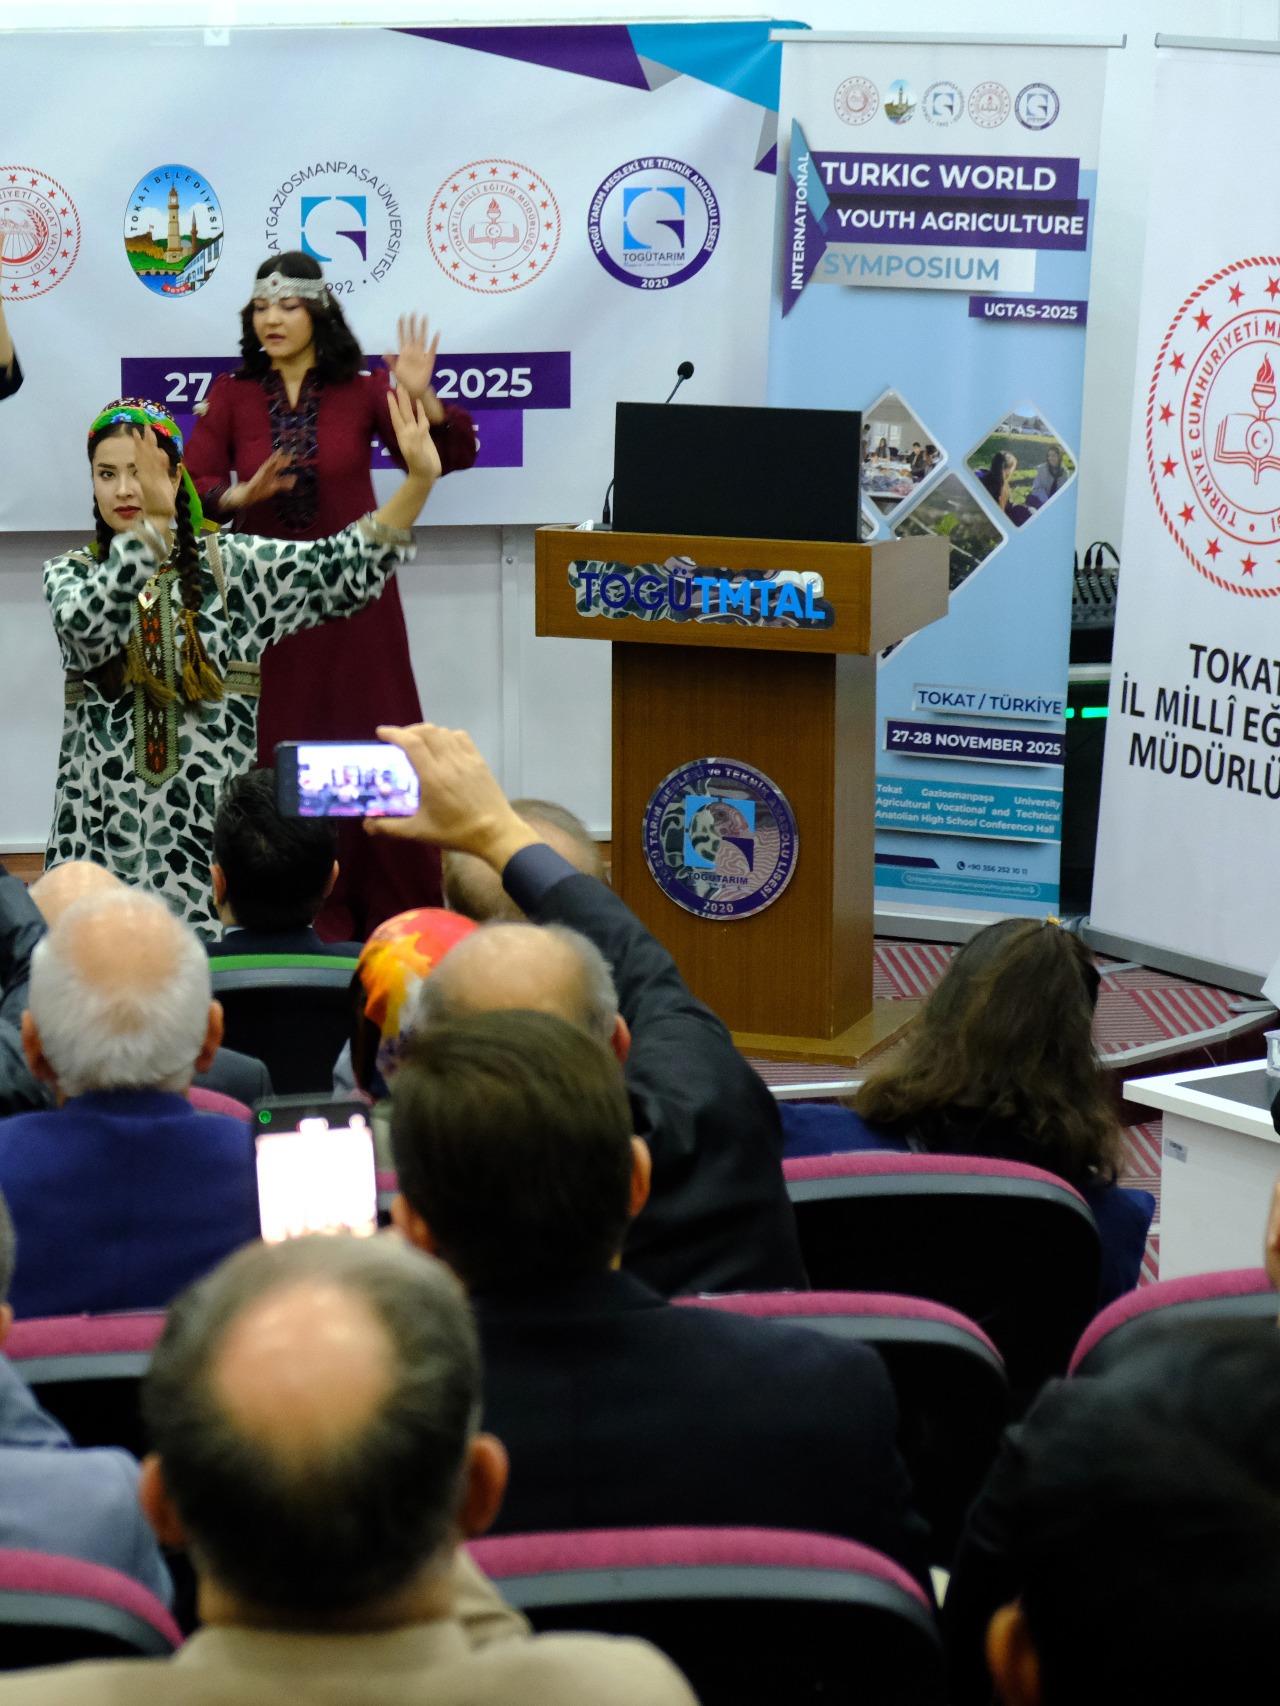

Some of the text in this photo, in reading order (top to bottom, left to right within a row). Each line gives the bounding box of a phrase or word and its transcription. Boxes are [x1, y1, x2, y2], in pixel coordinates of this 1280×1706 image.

[641, 159, 655, 168] VE
[690, 175, 718, 217] ANADOLU
[821, 161, 1056, 191] TURKIC WORLD
[35, 197, 58, 228] TOKAT
[131, 186, 150, 231] TOKAT
[790, 151, 810, 290] INTERNATIONAL
[836, 208, 1084, 235] YOUTH AGRICULTURE
[823, 252, 999, 281] SYMPOSIUM
[326, 279, 355, 295] 992
[640, 277, 669, 288] 2020
[984, 302, 1078, 320] UGTAS-2025
[435, 367, 533, 399] 2025
[1188, 316, 1259, 527] TÜRKİYE CUMHURİYETİ
[578, 567, 826, 620] TOGÜTMTAL
[918, 690, 976, 708] TOKAT
[989, 694, 1062, 715] TÜRKİYE
[1121, 671, 1145, 718] İL
[891, 729, 1062, 756] 27-28 NOVEMBER 2025
[875, 797, 1061, 821] Agricultural Vocational and Technical
[876, 783, 903, 794] Tokat
[1014, 796, 1061, 810] University
[875, 810, 1055, 834] Anatolian High School Conference Hall
[703, 901, 734, 913] 2020
